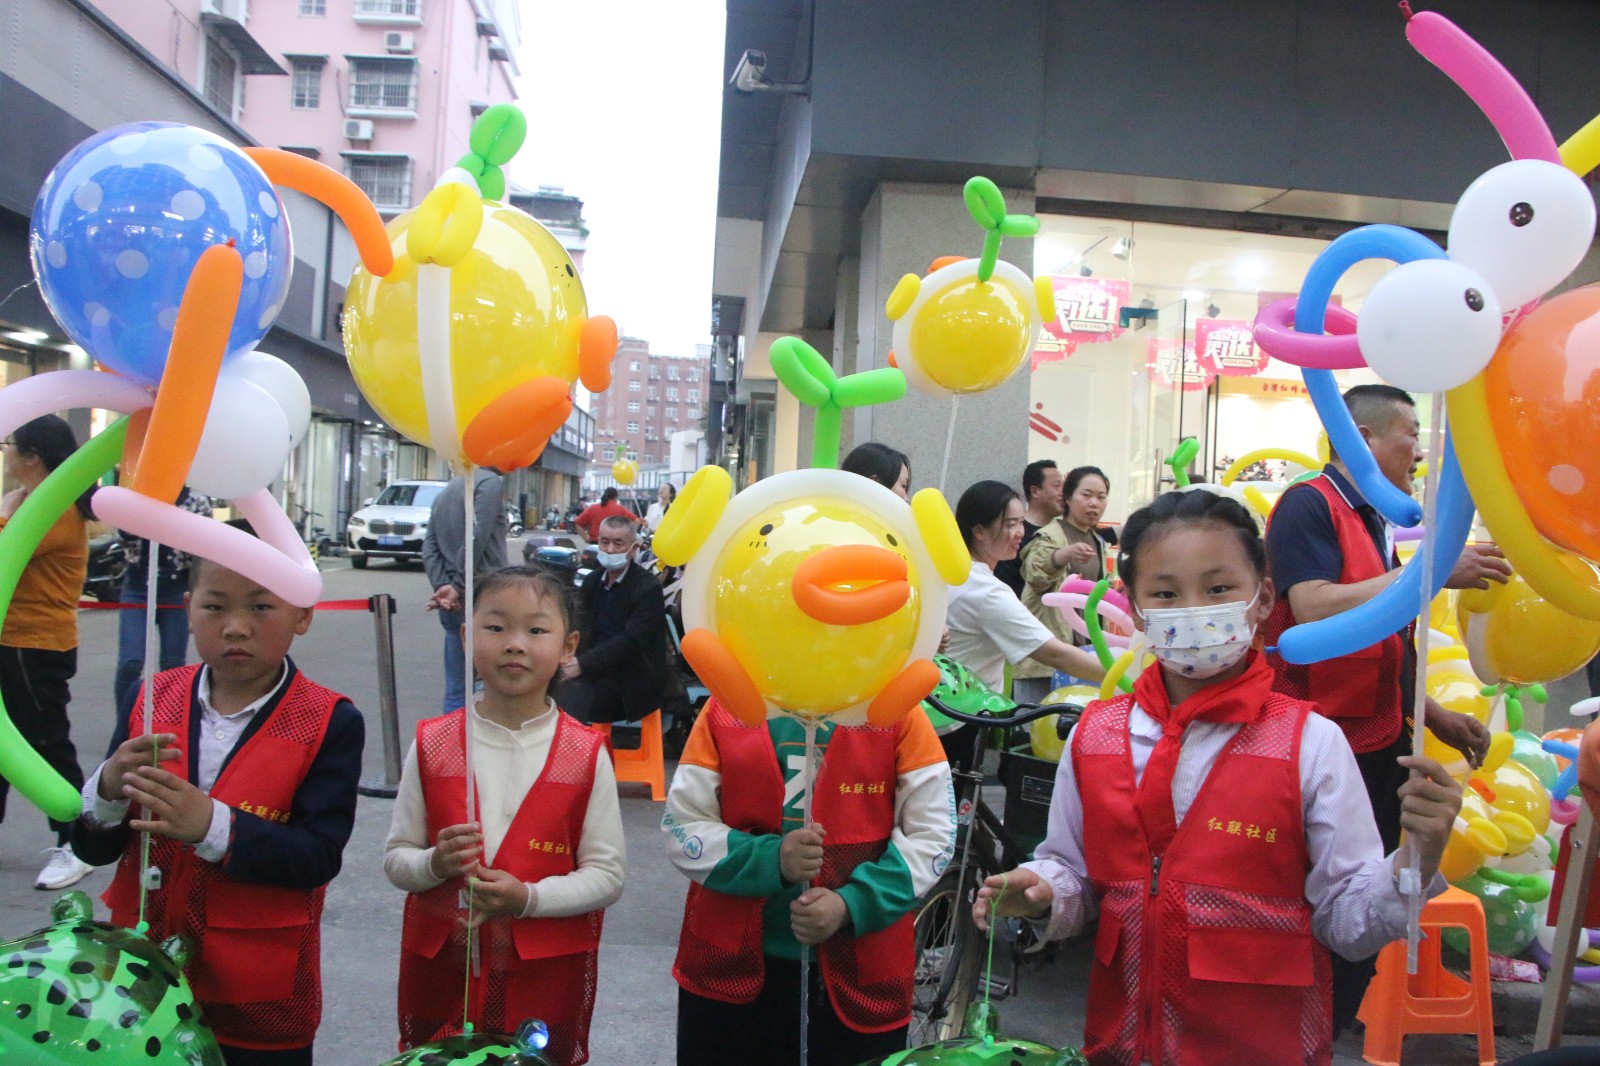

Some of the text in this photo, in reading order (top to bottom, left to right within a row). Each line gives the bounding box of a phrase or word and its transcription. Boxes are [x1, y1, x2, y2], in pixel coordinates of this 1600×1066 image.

[838, 780, 887, 796] 红联社区
[1206, 816, 1278, 844] 红联社区
